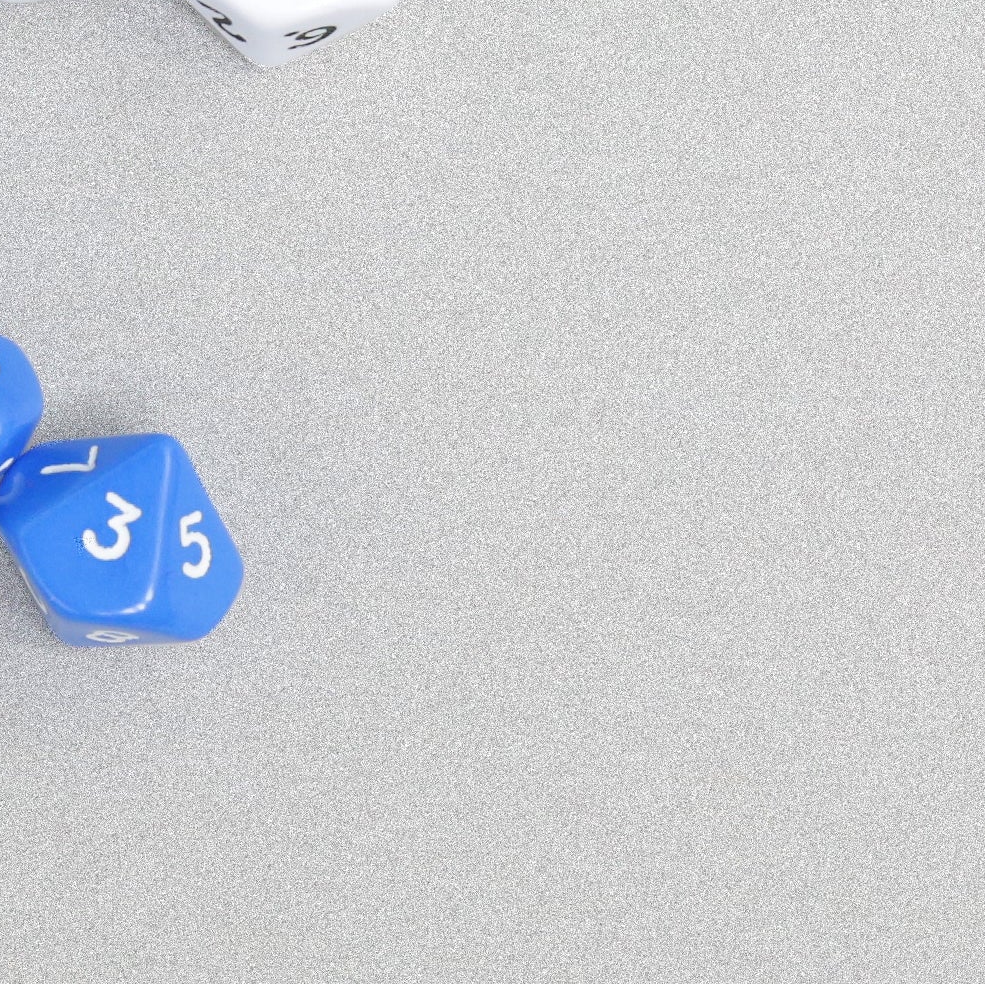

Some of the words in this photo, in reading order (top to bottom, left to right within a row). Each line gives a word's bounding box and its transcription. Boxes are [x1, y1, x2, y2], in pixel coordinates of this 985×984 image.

[40, 444, 100, 476] 7
[81, 491, 143, 562] 3
[178, 509, 213, 580] 5
